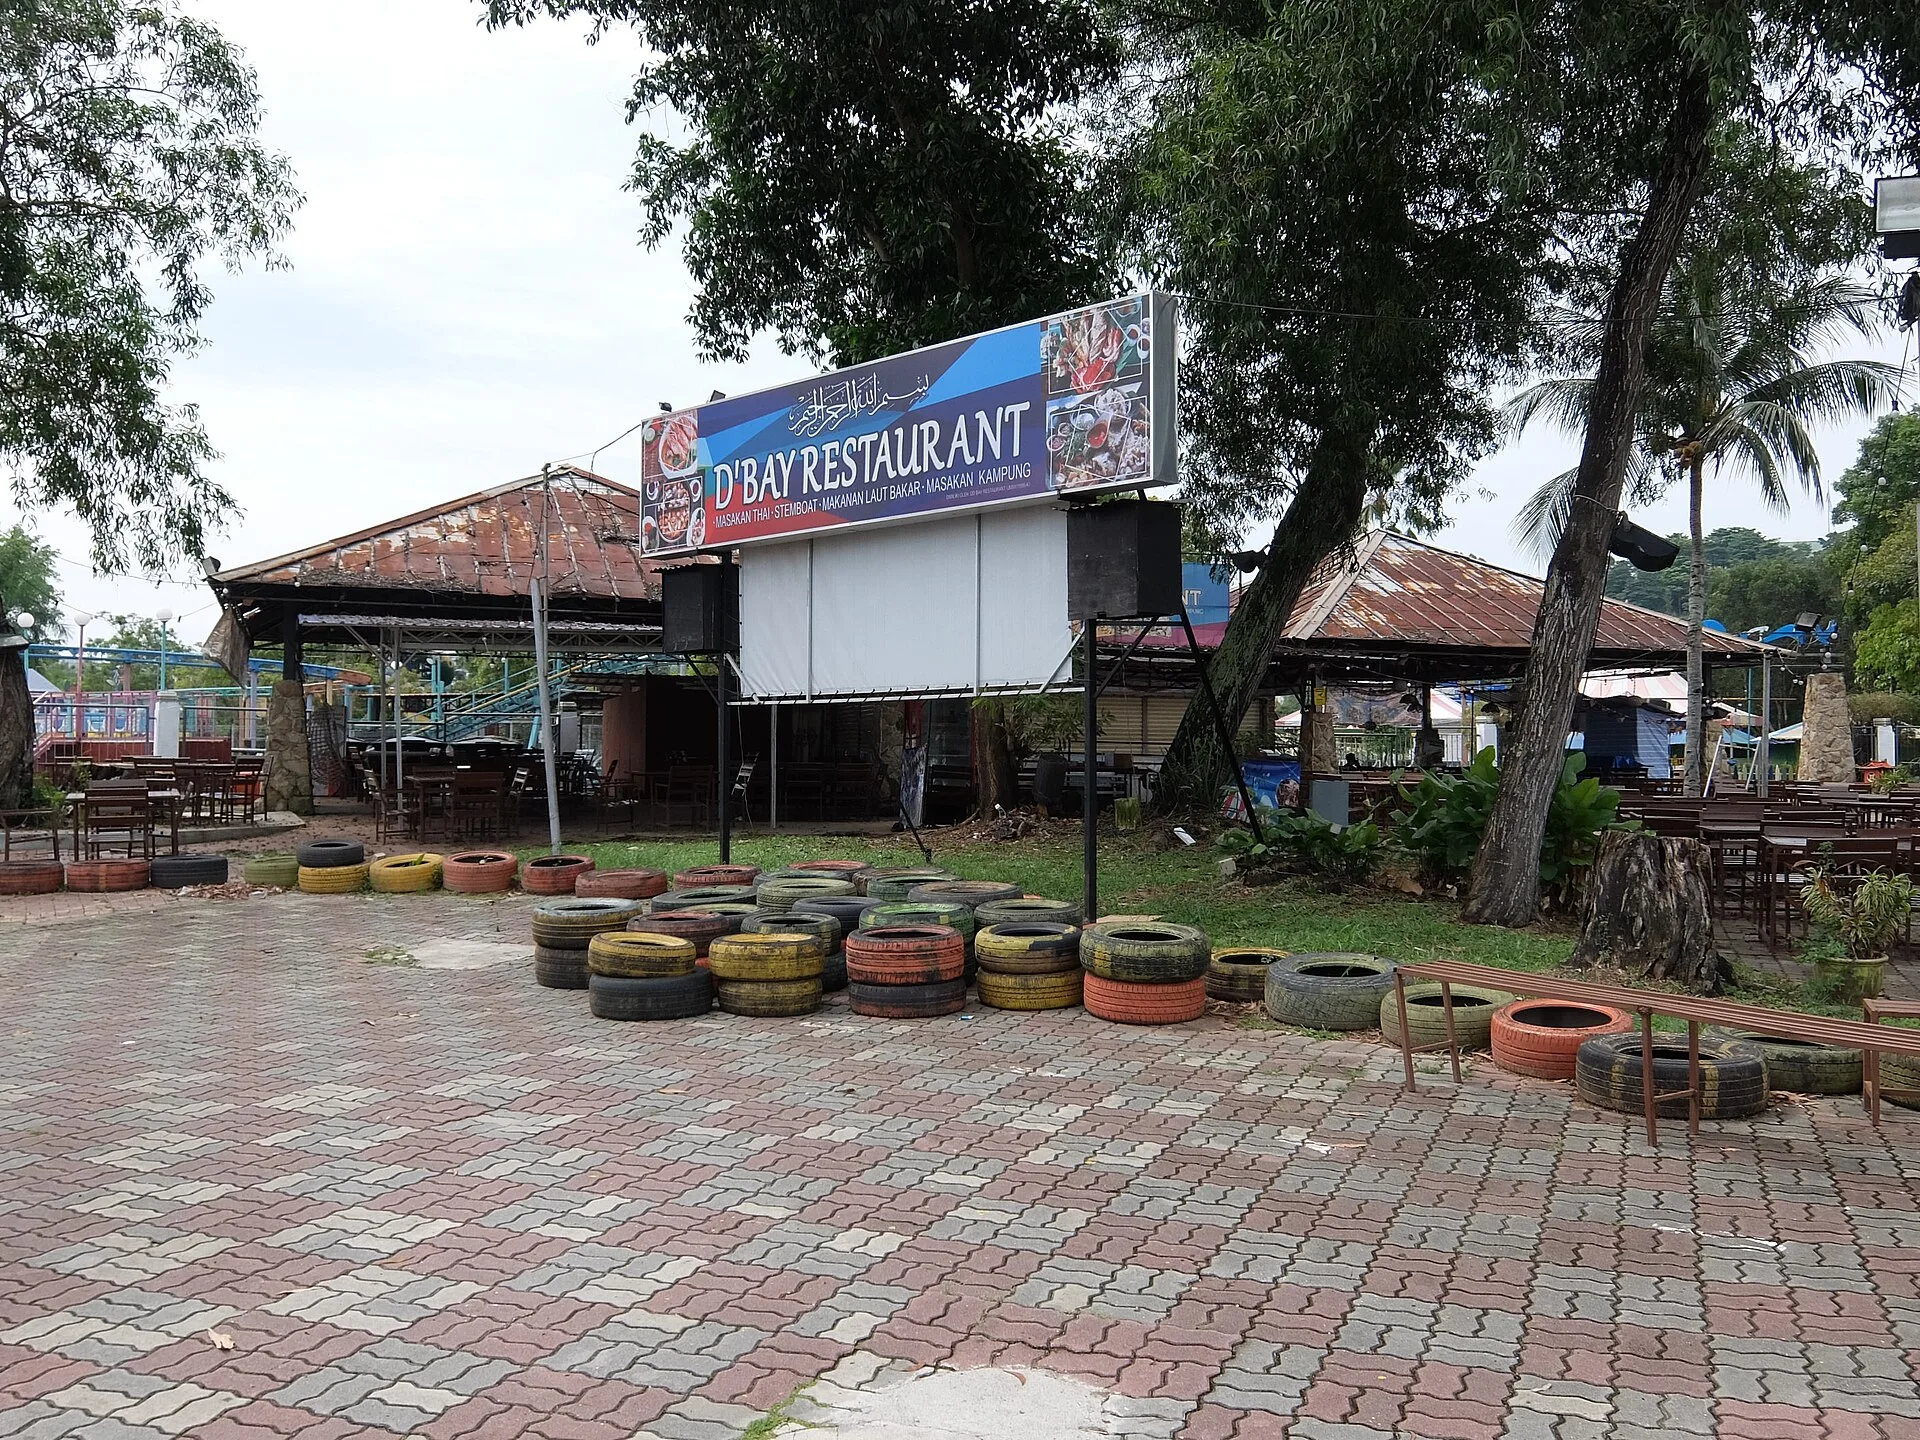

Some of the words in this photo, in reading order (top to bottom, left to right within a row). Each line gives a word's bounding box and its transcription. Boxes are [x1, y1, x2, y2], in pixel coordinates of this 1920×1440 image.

[713, 449, 797, 510] D'BAY
[800, 400, 1031, 495] RESTAURANT
[715, 509, 751, 528] MASAKAN
[753, 508, 770, 521] THAI
[774, 498, 819, 519] STEMBOAT
[821, 491, 864, 511] MAKANAN
[865, 486, 889, 504] LAUT
[890, 480, 921, 500] BAKAR
[926, 472, 974, 493] MASAKAN
[978, 462, 1031, 485] KAMPUNG
